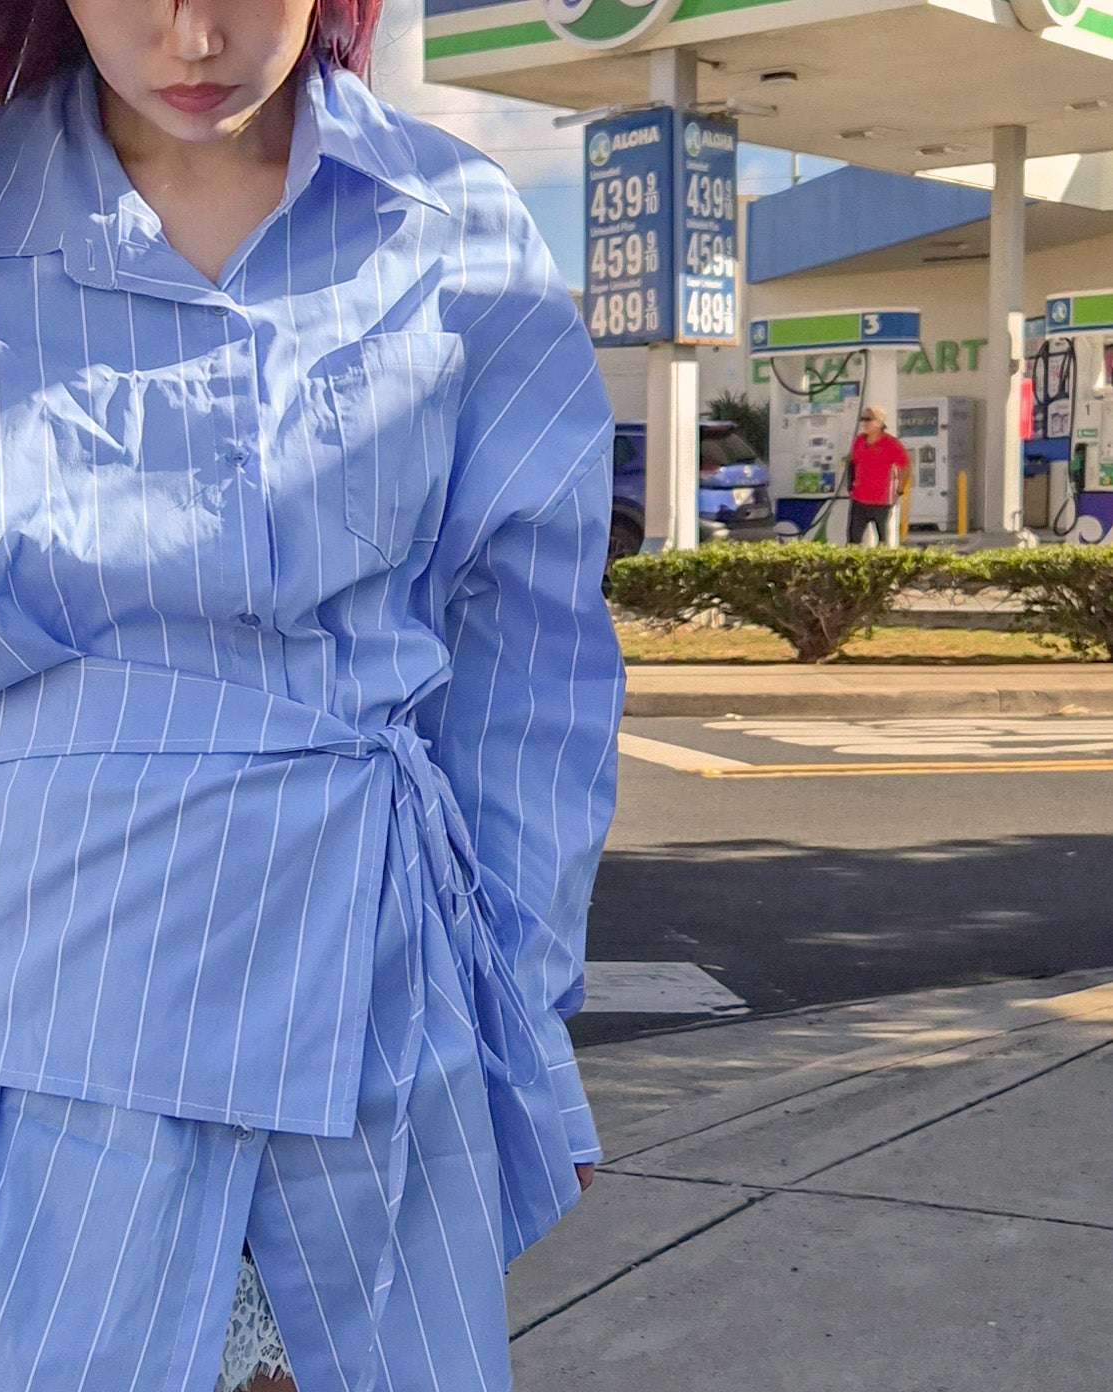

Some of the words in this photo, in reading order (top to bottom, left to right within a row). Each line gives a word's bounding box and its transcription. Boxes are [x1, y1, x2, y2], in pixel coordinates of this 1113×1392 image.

[612, 125, 660, 151] ALOHA
[702, 130, 734, 151] ALOHA
[590, 175, 642, 224] 439
[687, 173, 724, 219] 439
[590, 234, 642, 279] 459
[687, 232, 724, 276] 459
[590, 291, 642, 337] 489
[687, 290, 724, 334] 489
[863, 314, 880, 335] 3
[900, 338, 989, 374] ART
